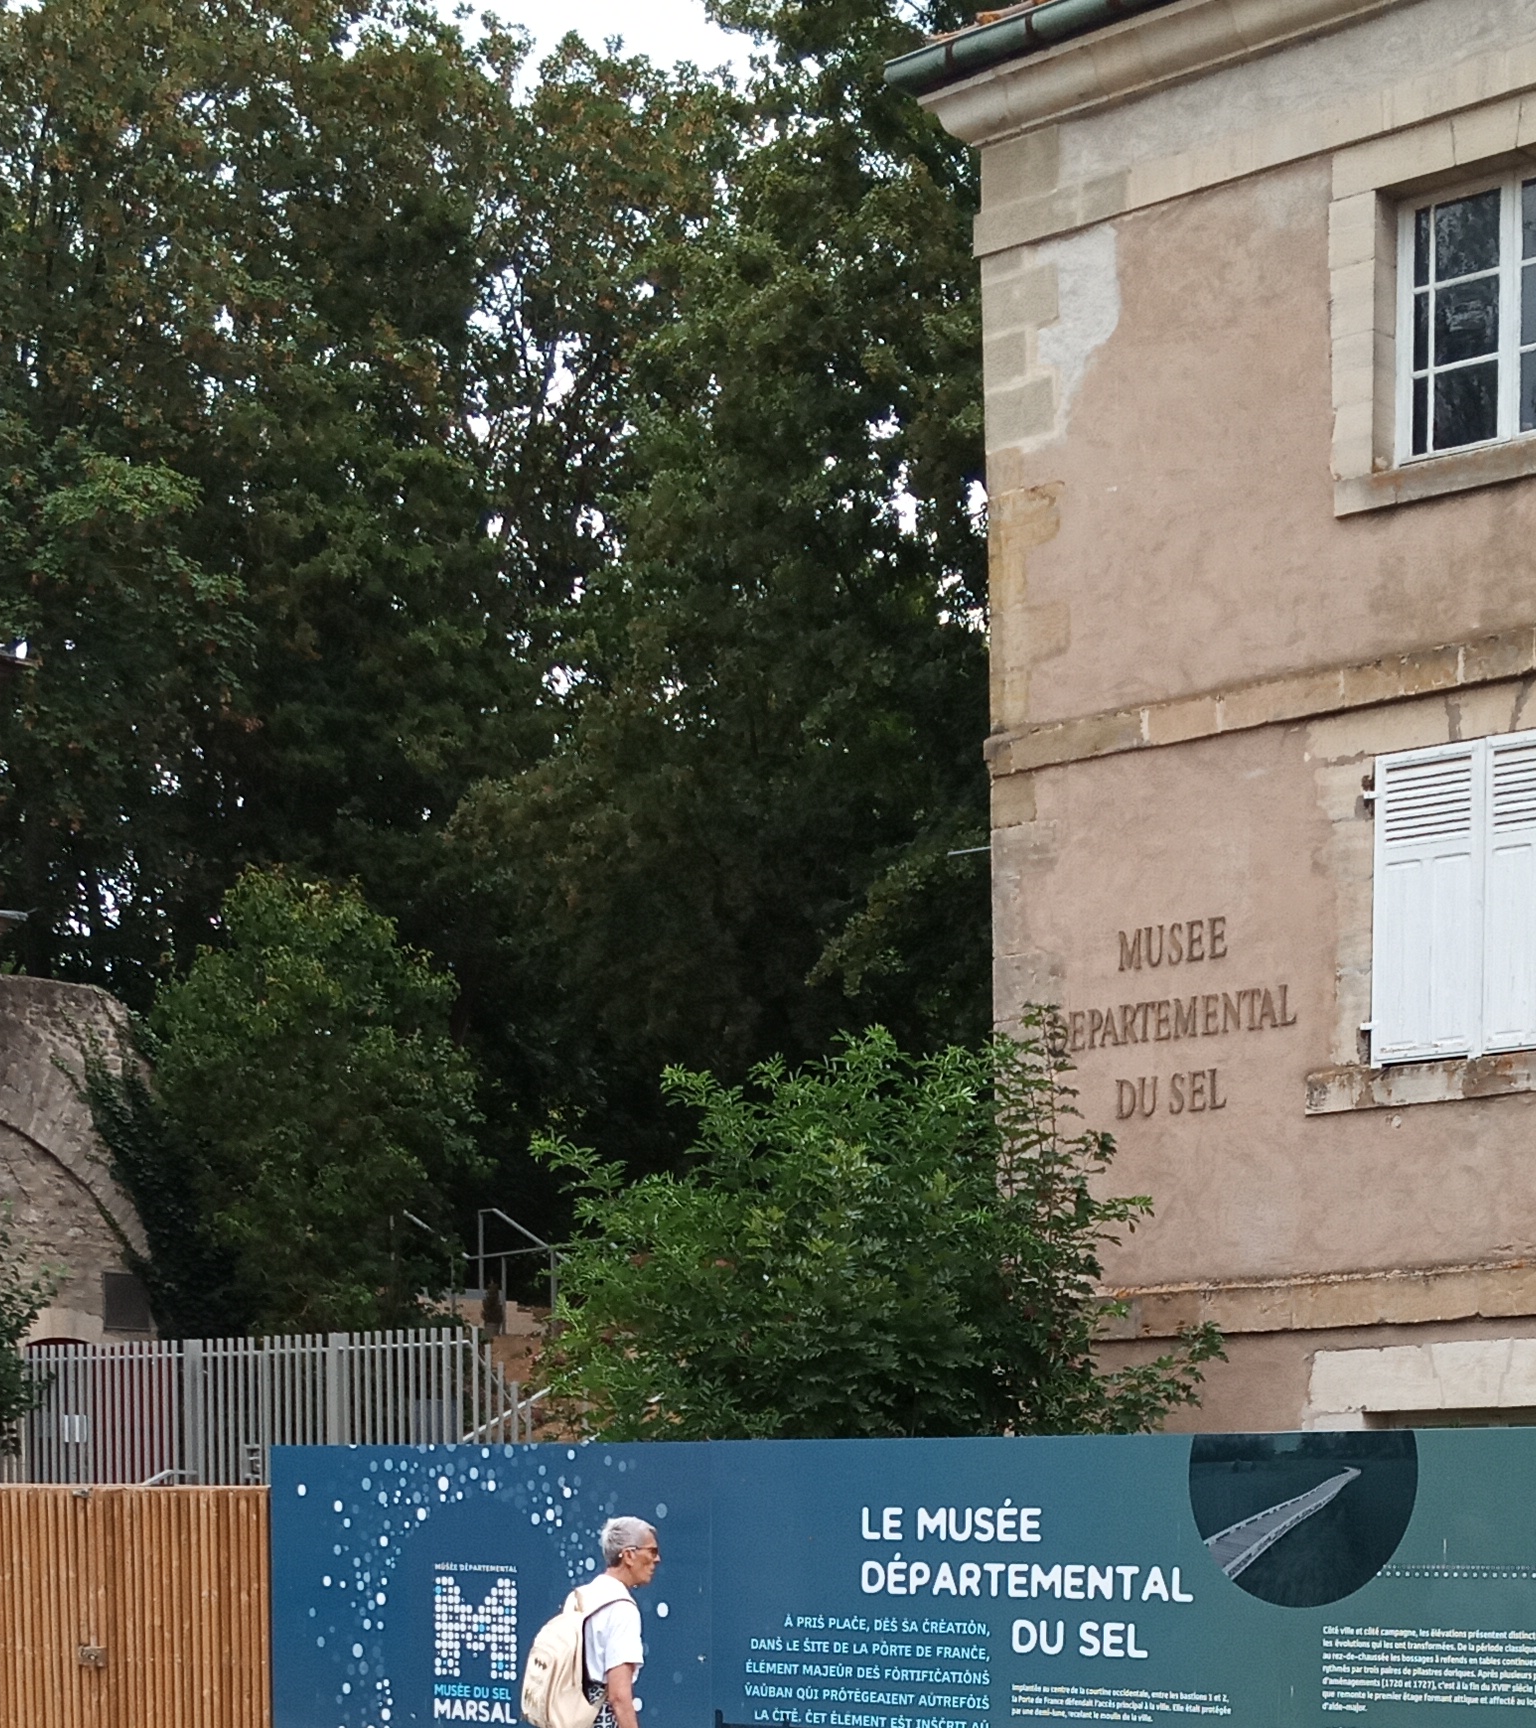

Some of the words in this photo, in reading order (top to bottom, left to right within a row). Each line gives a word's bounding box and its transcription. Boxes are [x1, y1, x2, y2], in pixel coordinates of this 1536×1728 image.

[1118, 916, 1228, 972] MUSEE
[1115, 1076, 1158, 1120] DU
[1169, 1067, 1227, 1115] SEL
[861, 1506, 903, 1540] LE
[917, 1499, 1042, 1542] MUSÉE
[861, 1552, 1194, 1603] DÉPARTEMENTAL
[786, 1640, 800, 1652] LE
[833, 1641, 849, 1654] DE
[853, 1643, 869, 1654] LA
[916, 1645, 932, 1658] DE
[1012, 1619, 1064, 1655] DU
[1079, 1621, 1148, 1659] SEL
[434, 1683, 471, 1698] MUSÉE
[473, 1686, 490, 1699] DU
[492, 1687, 512, 1701] SEL
[434, 1697, 517, 1725] MARSAL
[754, 1709, 770, 1721] LA
